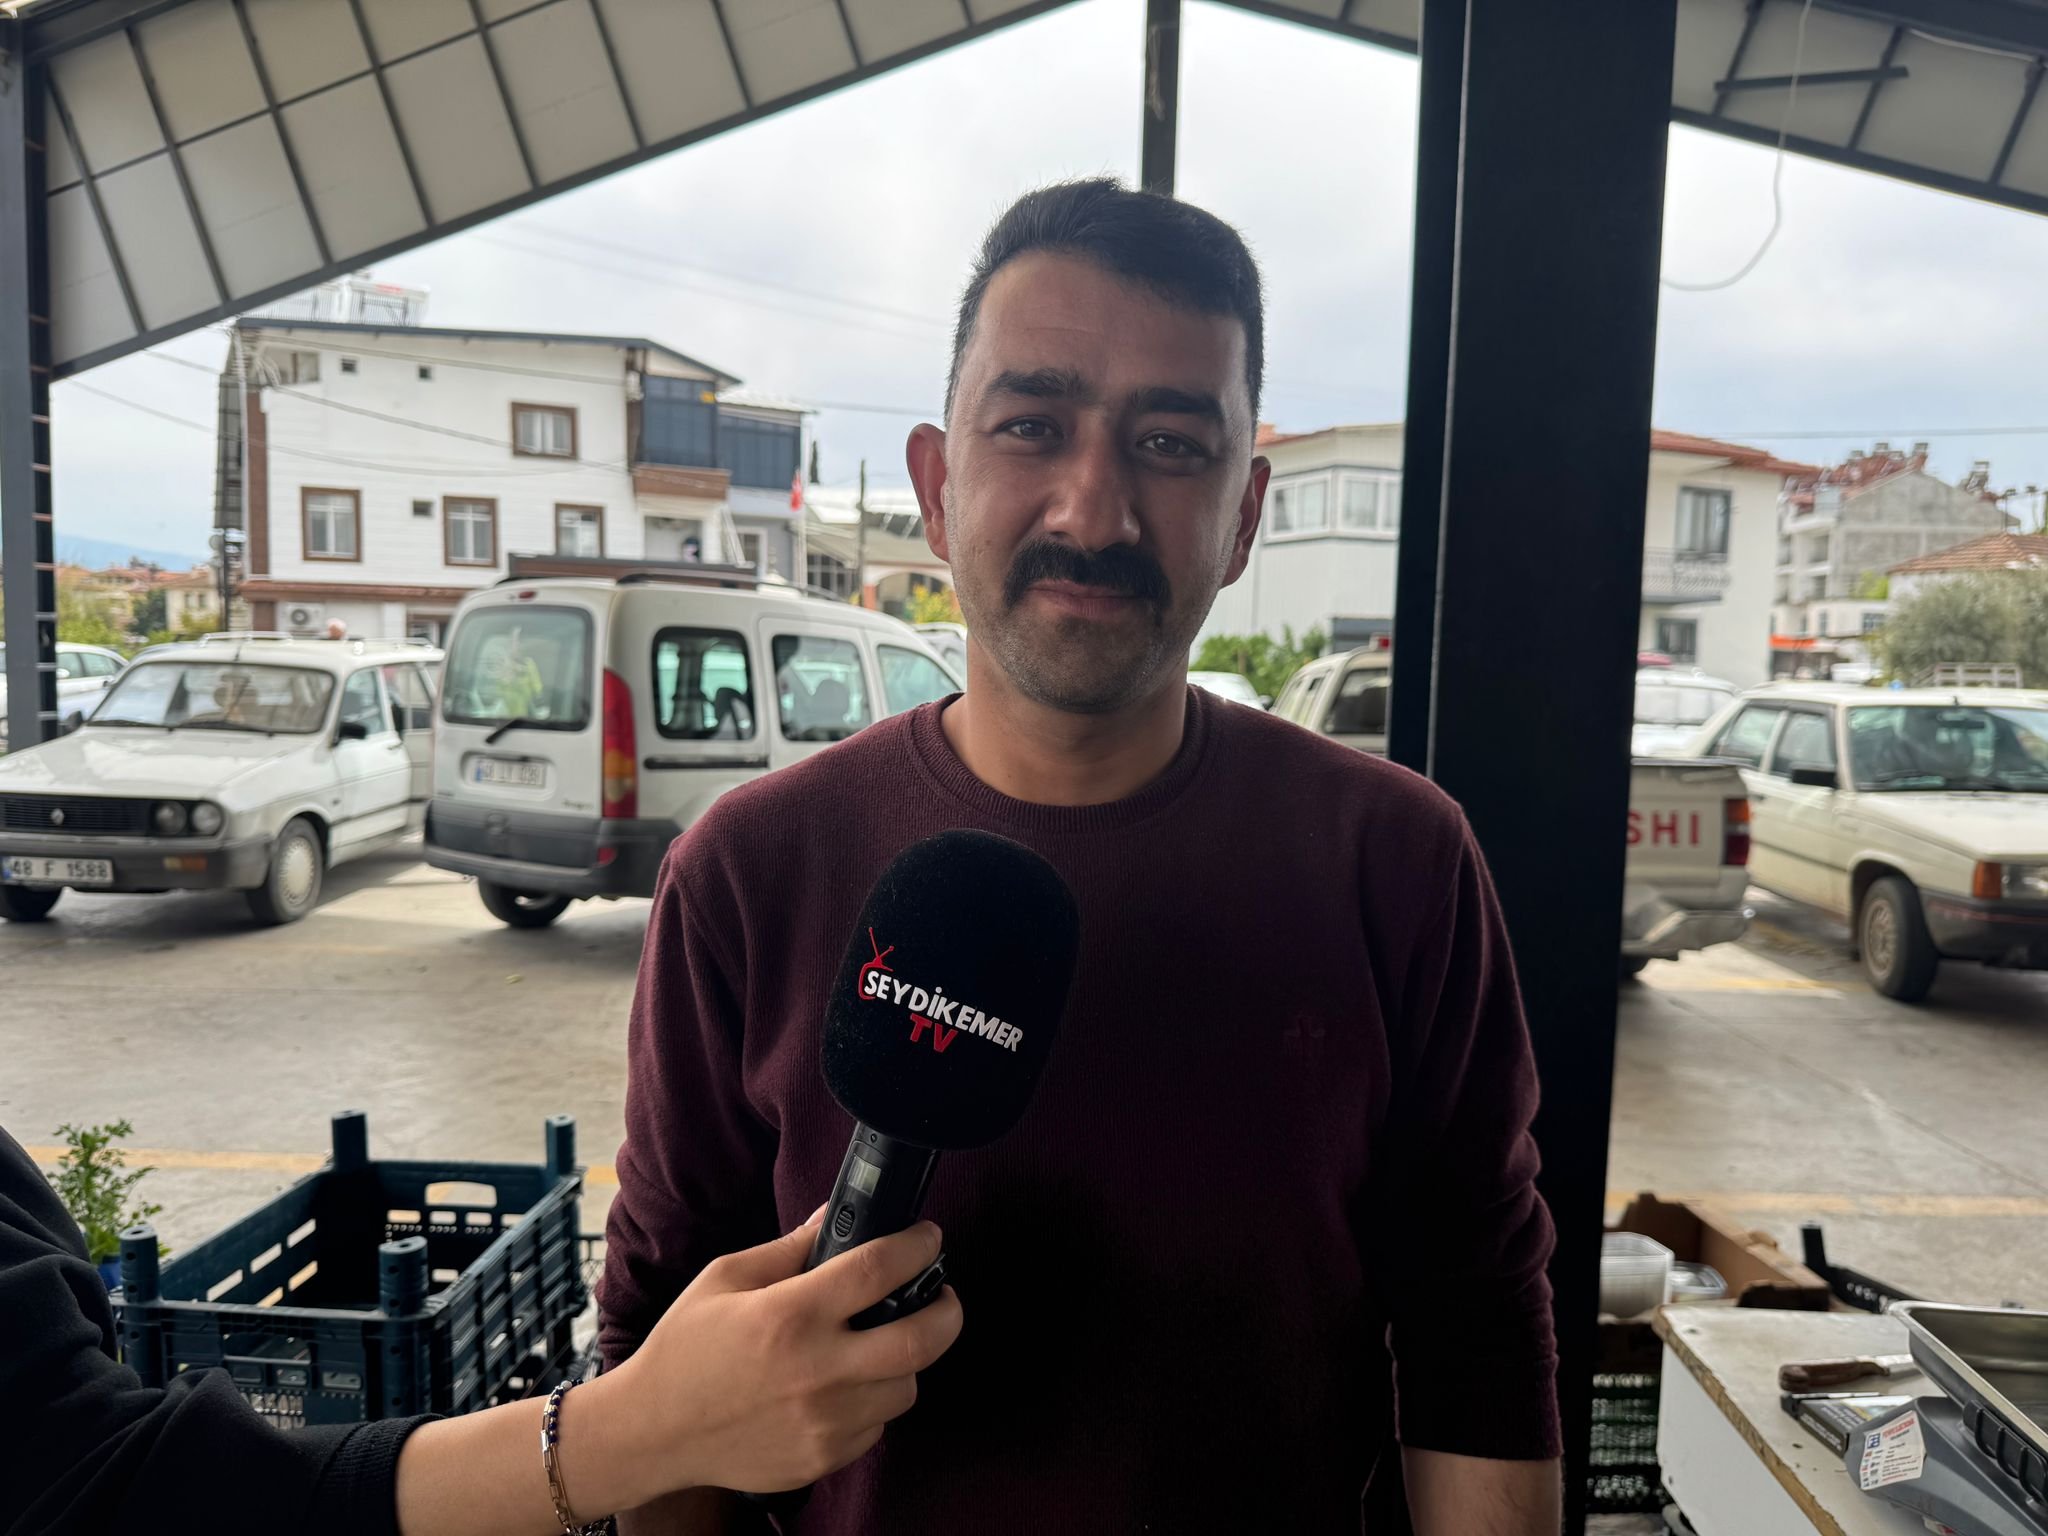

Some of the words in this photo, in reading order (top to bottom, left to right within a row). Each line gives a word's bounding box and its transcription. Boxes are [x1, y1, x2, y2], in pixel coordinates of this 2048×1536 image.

[44, 861, 54, 876] F
[864, 970, 1023, 1052] SEYDİKEMER
[910, 1013, 958, 1053] TV
